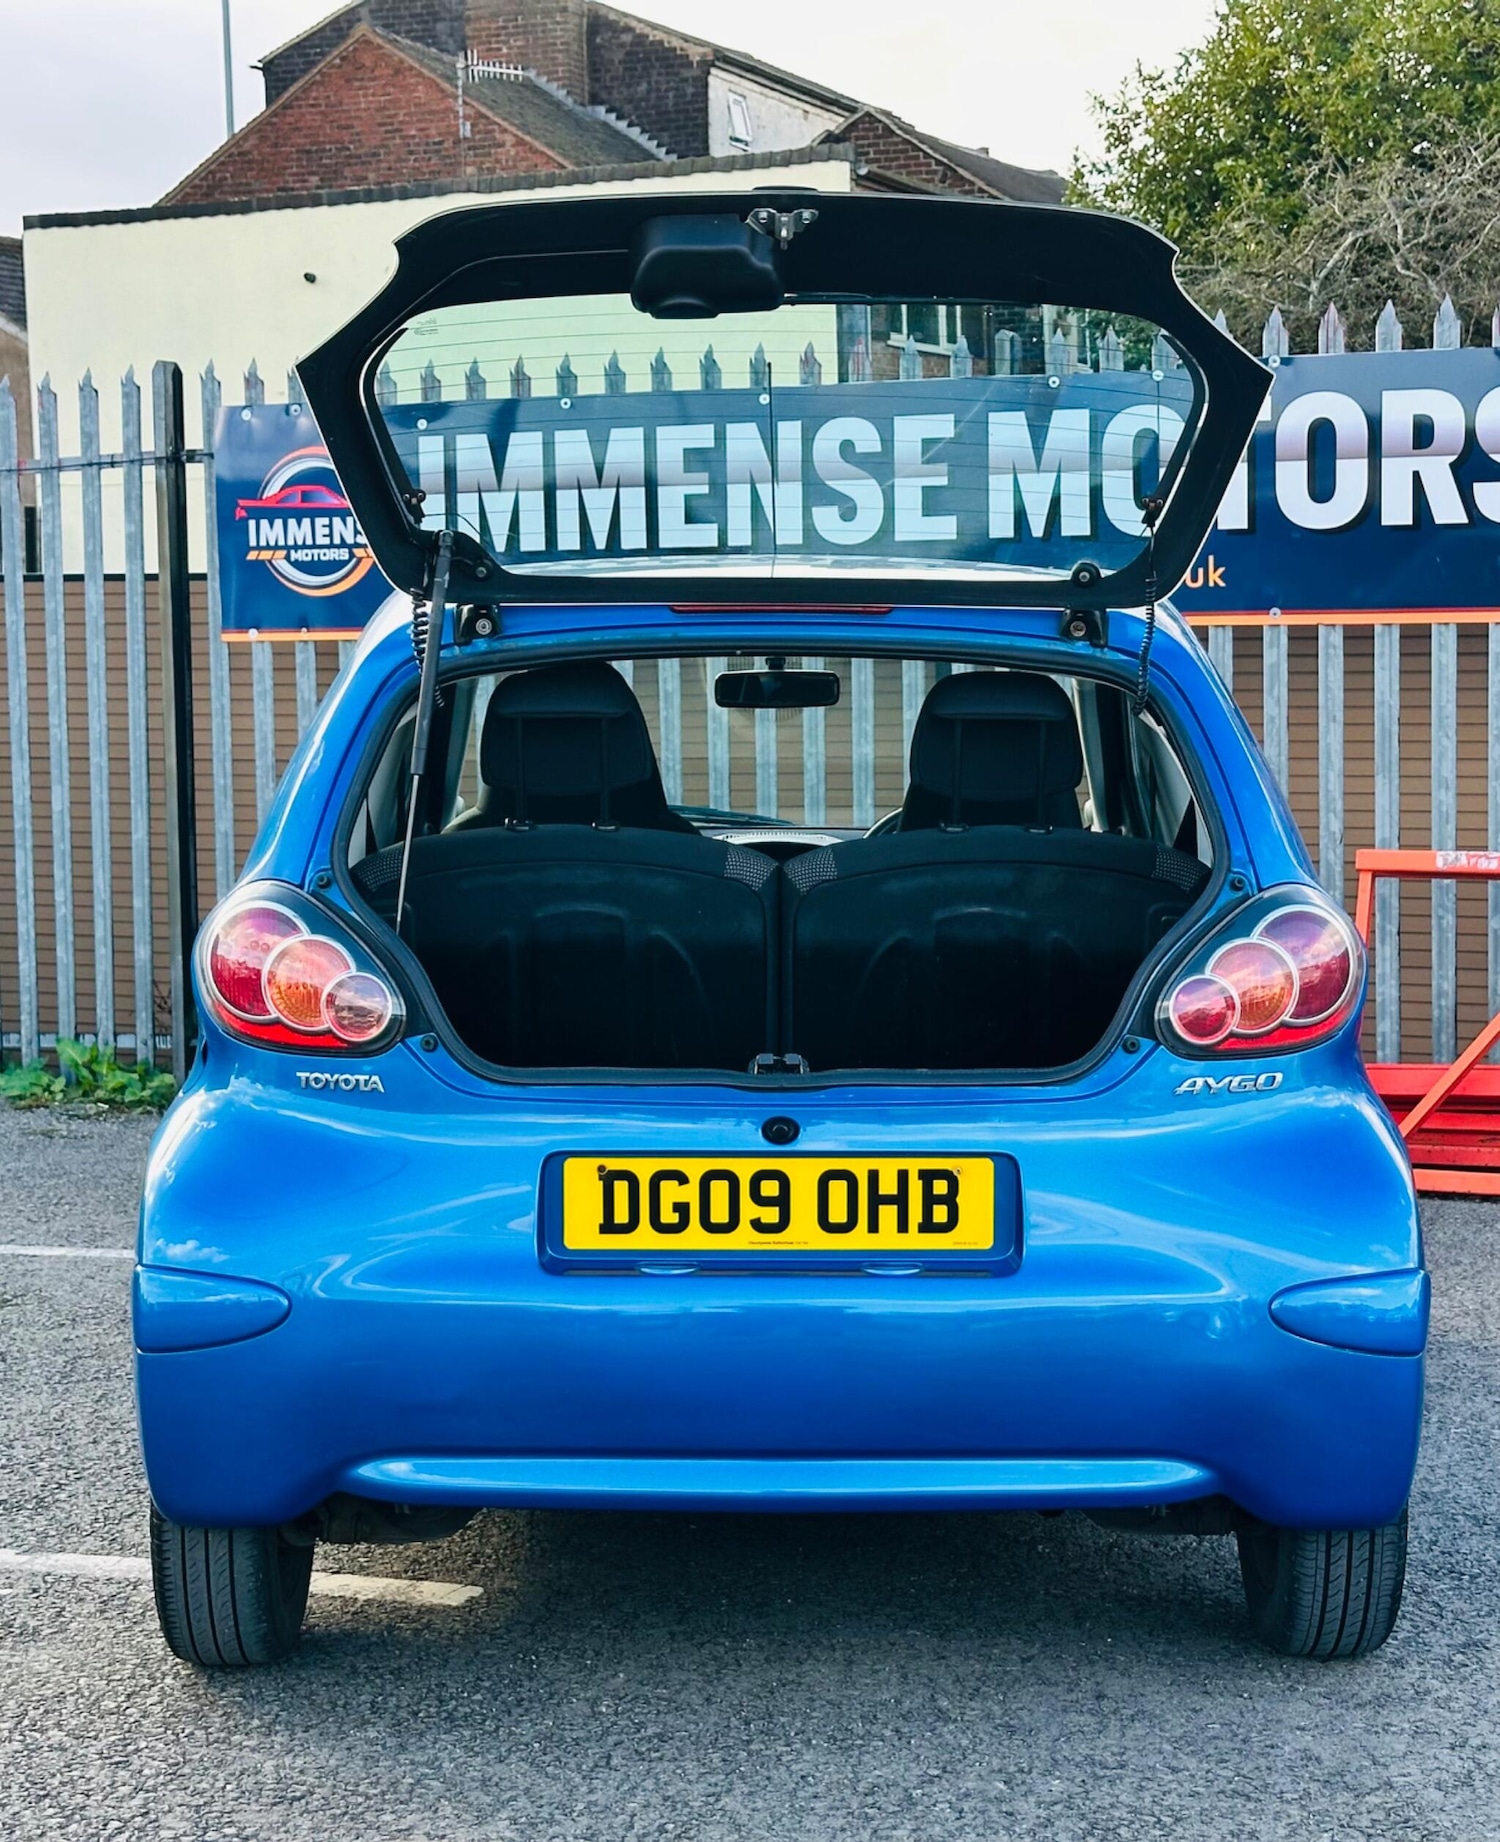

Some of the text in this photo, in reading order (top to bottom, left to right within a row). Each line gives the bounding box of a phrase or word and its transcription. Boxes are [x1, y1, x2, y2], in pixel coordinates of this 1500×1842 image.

[418, 382, 1500, 553] IMMENSE MOOR
[289, 548, 350, 562] MOTORS
[295, 1071, 385, 1094] TOYOTA
[1173, 1072, 1284, 1096] AYGO
[598, 1168, 960, 1235] DG09 OHB
